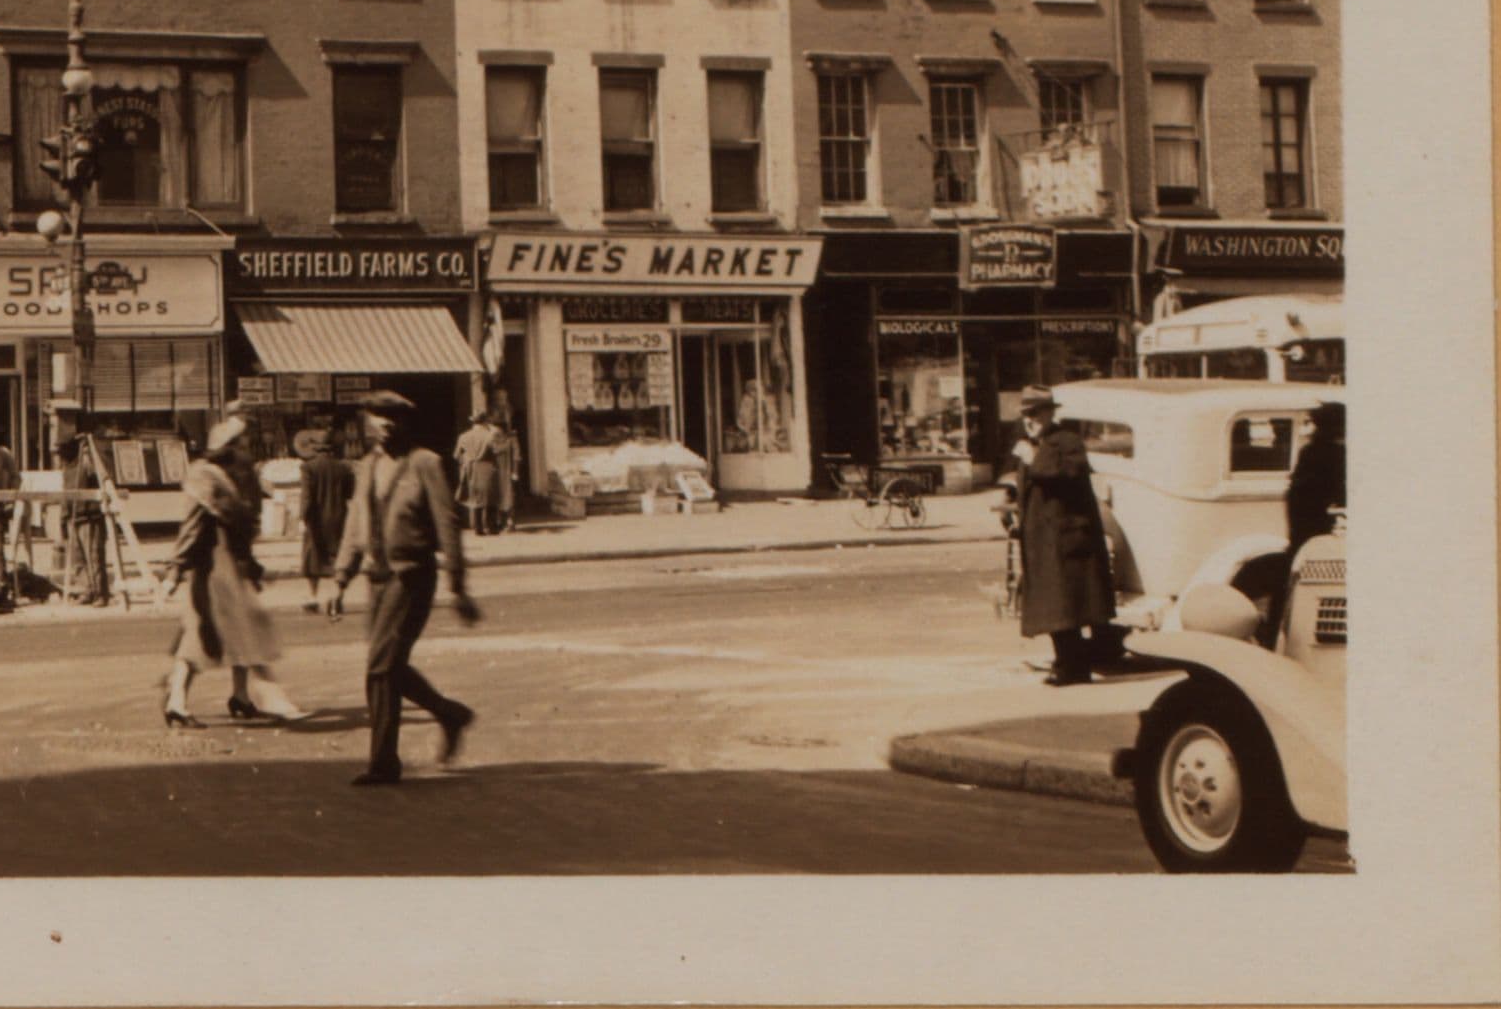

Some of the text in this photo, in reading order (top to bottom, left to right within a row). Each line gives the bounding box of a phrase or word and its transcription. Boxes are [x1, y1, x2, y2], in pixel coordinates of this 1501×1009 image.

[1185, 235, 1310, 257] WASHINGTON
[238, 252, 468, 278] SHEFFIELD FARMS CO.
[507, 241, 803, 277] FINE'S MARKET
[971, 263, 1053, 280] PHARMACY
[879, 322, 959, 334] BIOLOGICALS
[1040, 320, 1116, 333] PRESCRIPTIONS
[642, 333, 662, 348] 29
